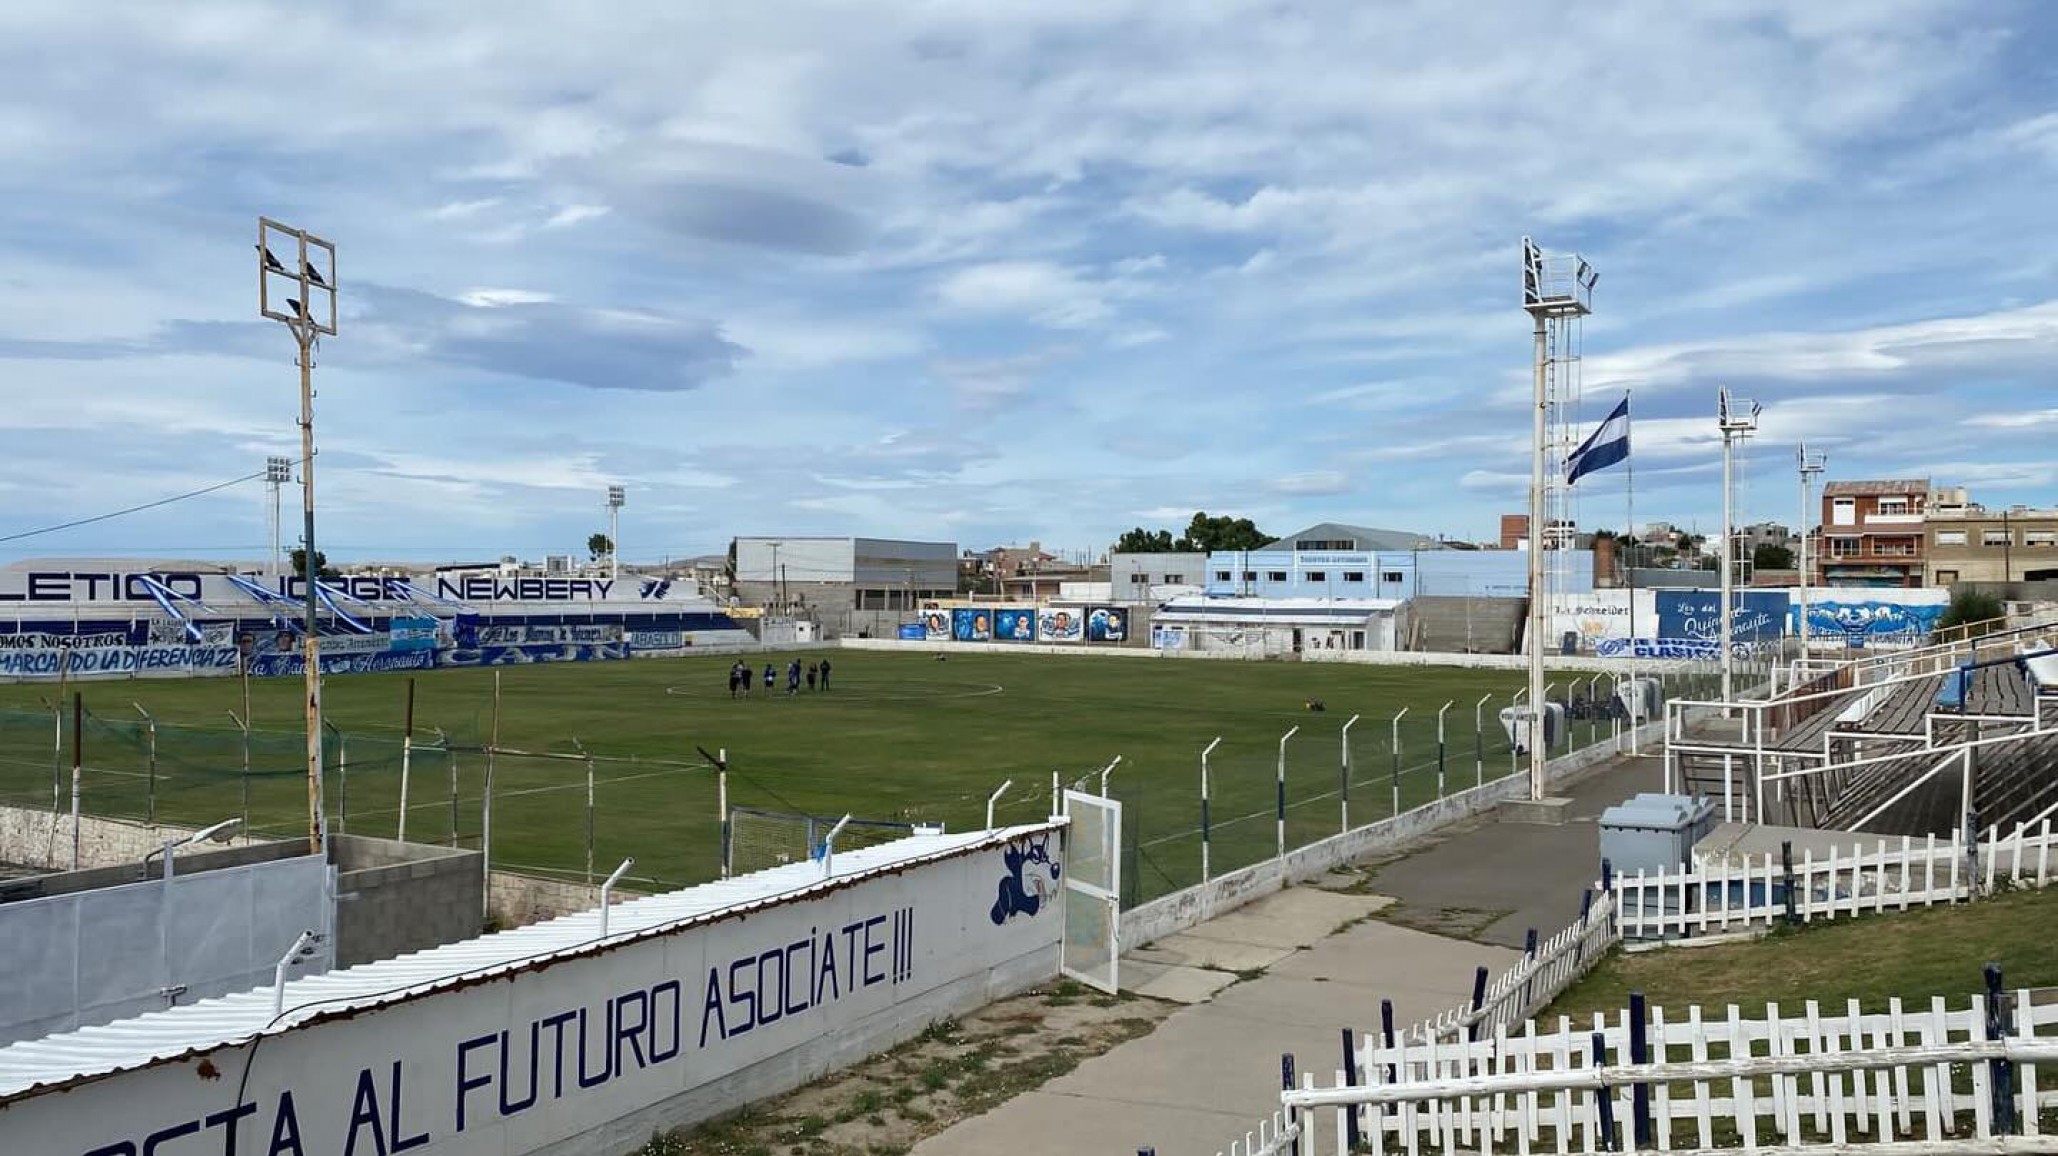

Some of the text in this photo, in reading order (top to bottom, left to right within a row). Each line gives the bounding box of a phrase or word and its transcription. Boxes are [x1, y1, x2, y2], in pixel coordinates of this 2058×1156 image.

[438, 577, 614, 600] NEWBERY
[40, 634, 124, 648] NOSOTROS
[100, 649, 120, 670] LA
[122, 647, 215, 670] DIFERENCIA
[344, 1061, 430, 1156] AL
[456, 980, 680, 1133] FUTURO
